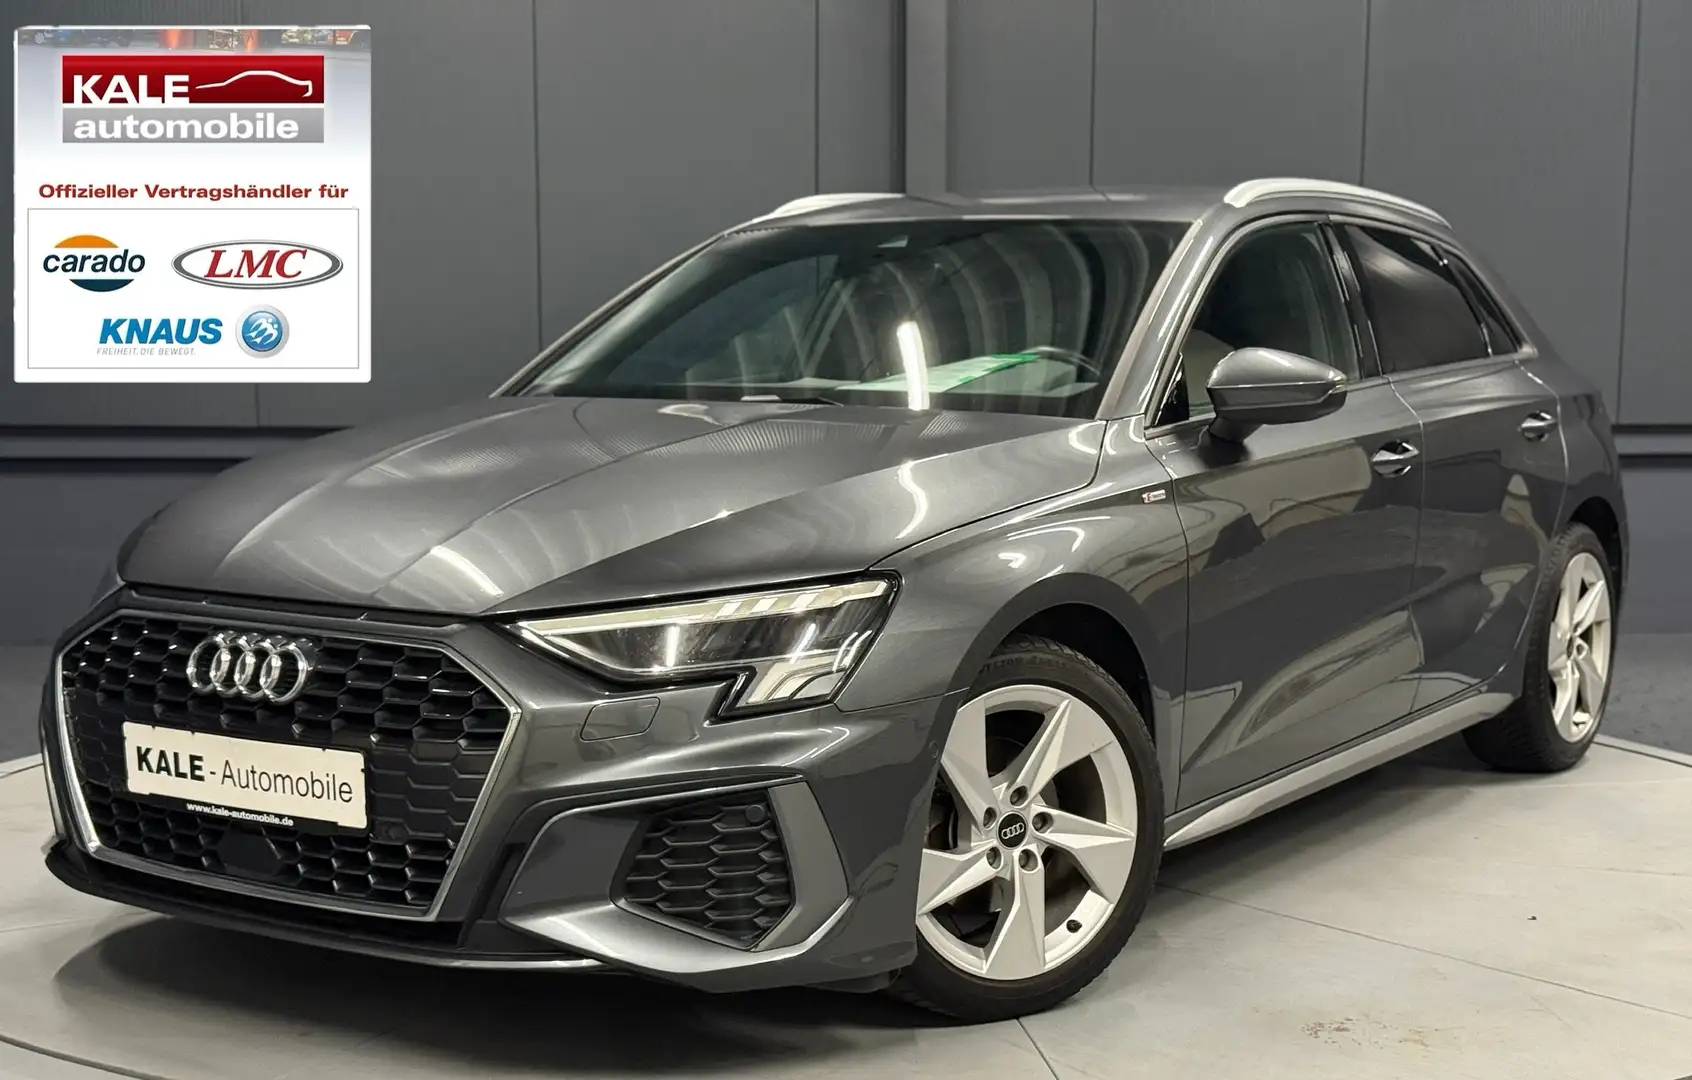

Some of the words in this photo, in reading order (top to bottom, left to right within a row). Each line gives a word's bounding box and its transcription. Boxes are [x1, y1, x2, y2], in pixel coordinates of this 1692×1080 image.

[136, 745, 205, 782] KALE
[221, 760, 353, 803] Automobile
[186, 802, 294, 827] www.kale-automobile.de
